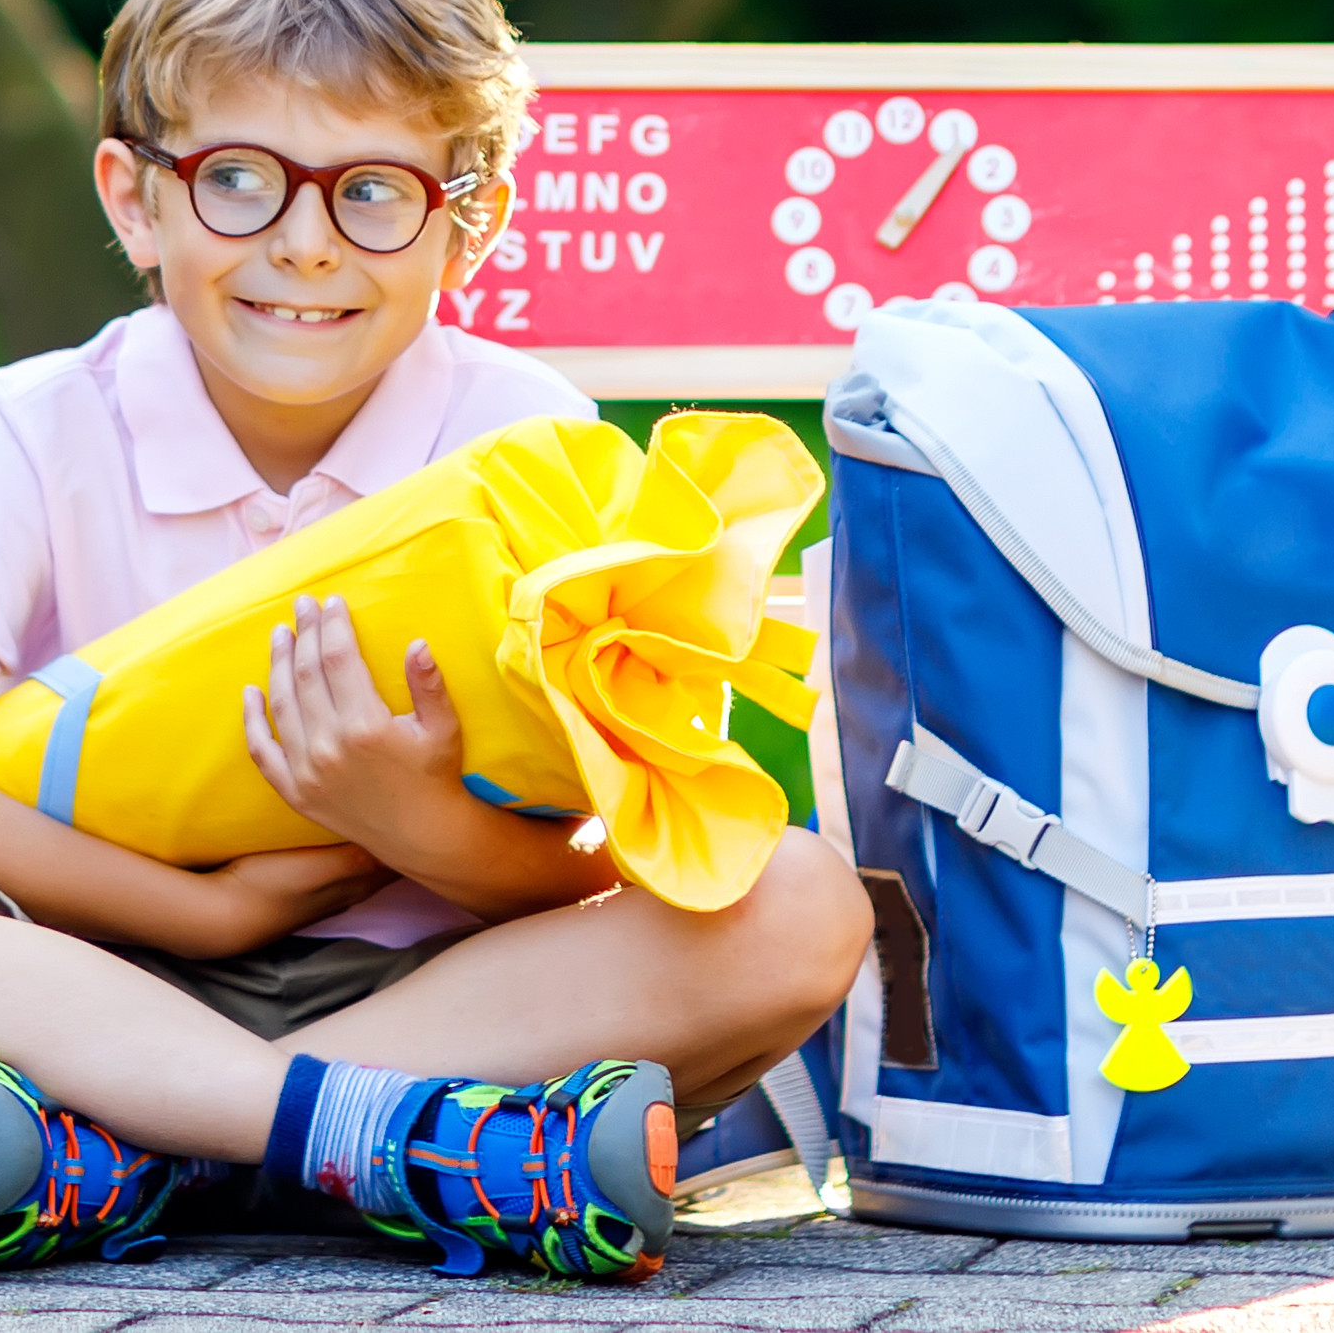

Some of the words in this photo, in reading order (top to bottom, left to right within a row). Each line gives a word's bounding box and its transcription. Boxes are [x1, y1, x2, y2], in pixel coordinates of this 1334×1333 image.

[887, 109, 916, 132] 12
[838, 121, 864, 144] 11
[797, 159, 827, 182] 10
